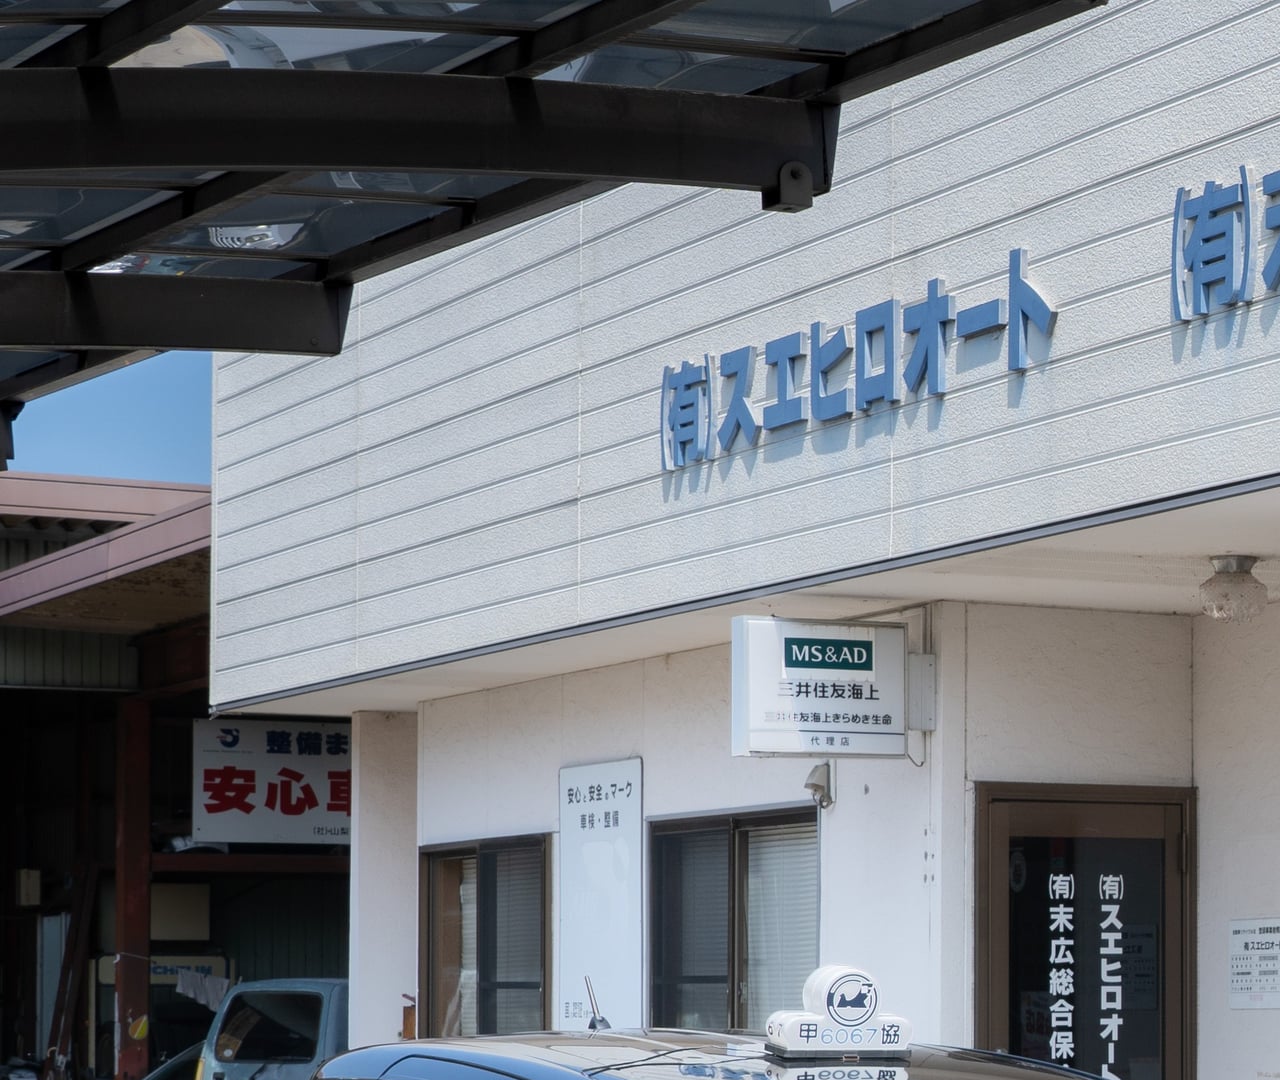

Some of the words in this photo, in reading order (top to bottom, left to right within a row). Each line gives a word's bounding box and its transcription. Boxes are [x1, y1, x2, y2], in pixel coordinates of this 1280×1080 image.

[791, 644, 867, 663] MS&AD
[777, 682, 880, 701] 三井住友海上
[810, 736, 850, 746] 代理店
[1049, 874, 1075, 1068] (有)末広総合保
